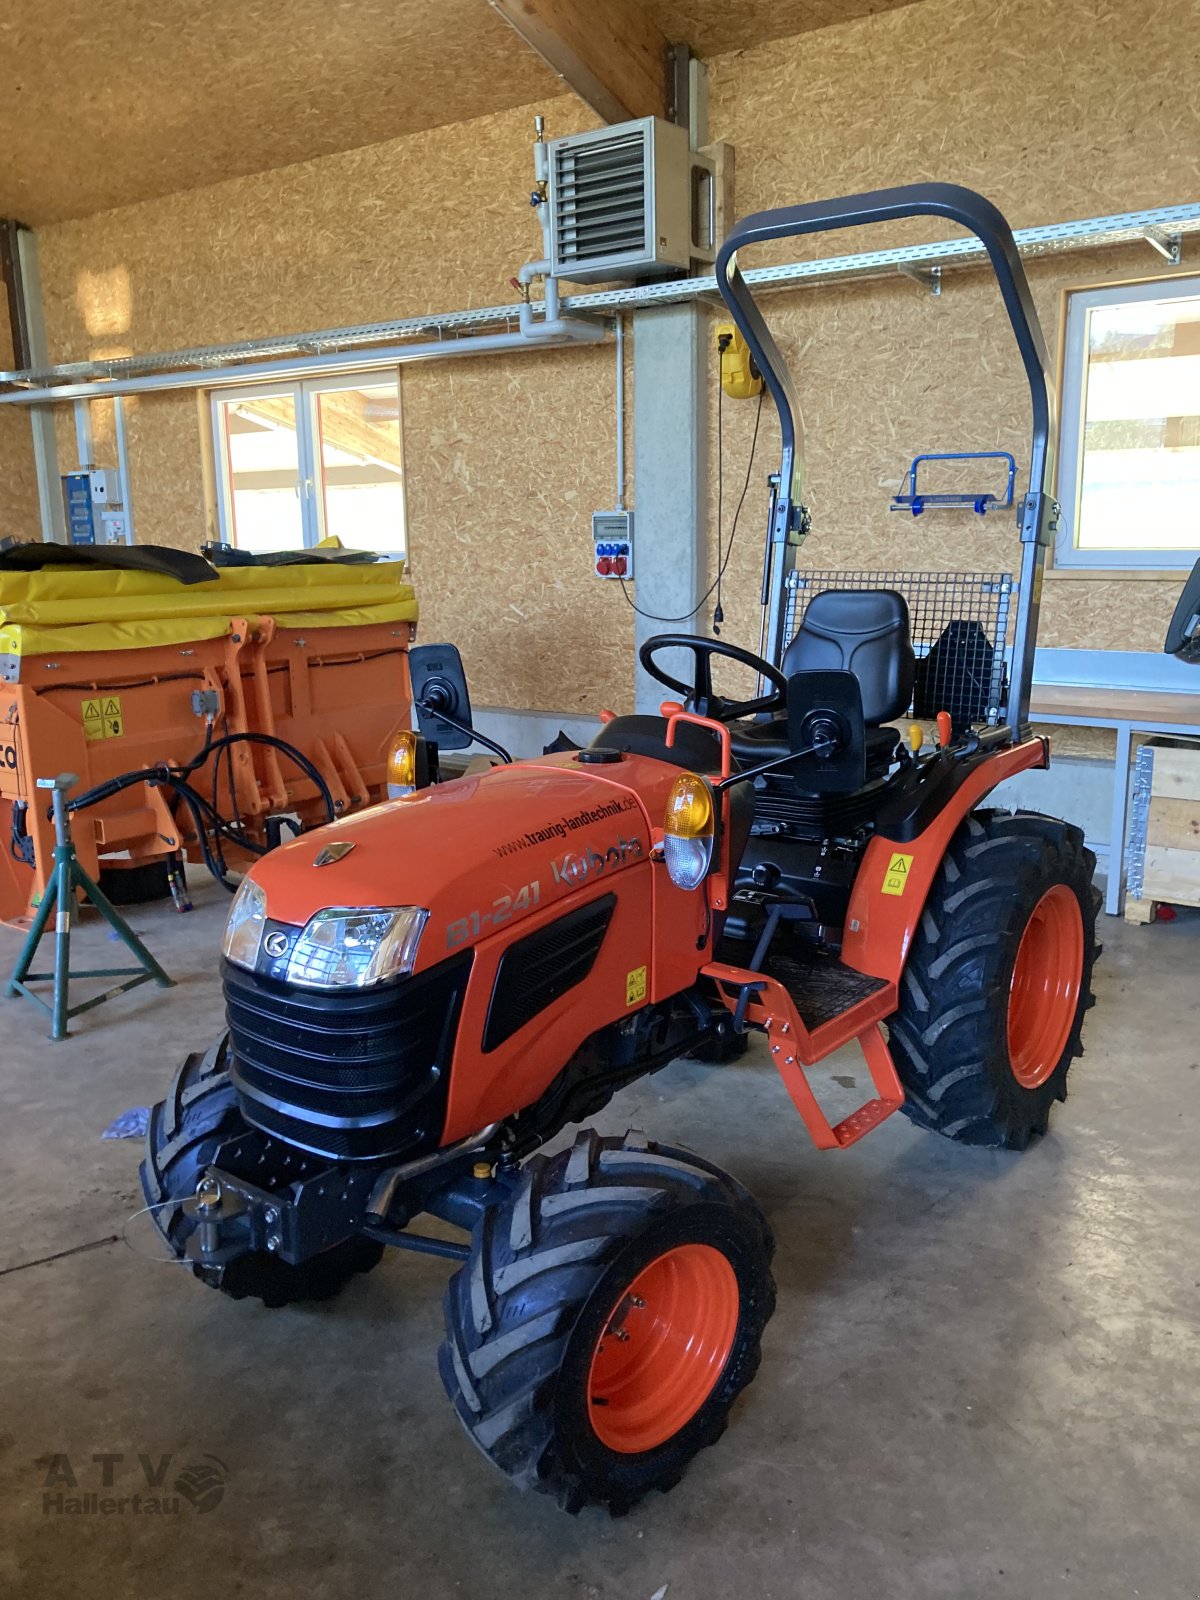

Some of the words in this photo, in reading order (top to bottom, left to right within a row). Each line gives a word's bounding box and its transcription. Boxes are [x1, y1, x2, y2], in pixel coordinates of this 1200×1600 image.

[492, 796, 638, 858] www.traurig-landtechnik.de
[551, 835, 643, 886] Kubota
[447, 881, 540, 948] B1-241
